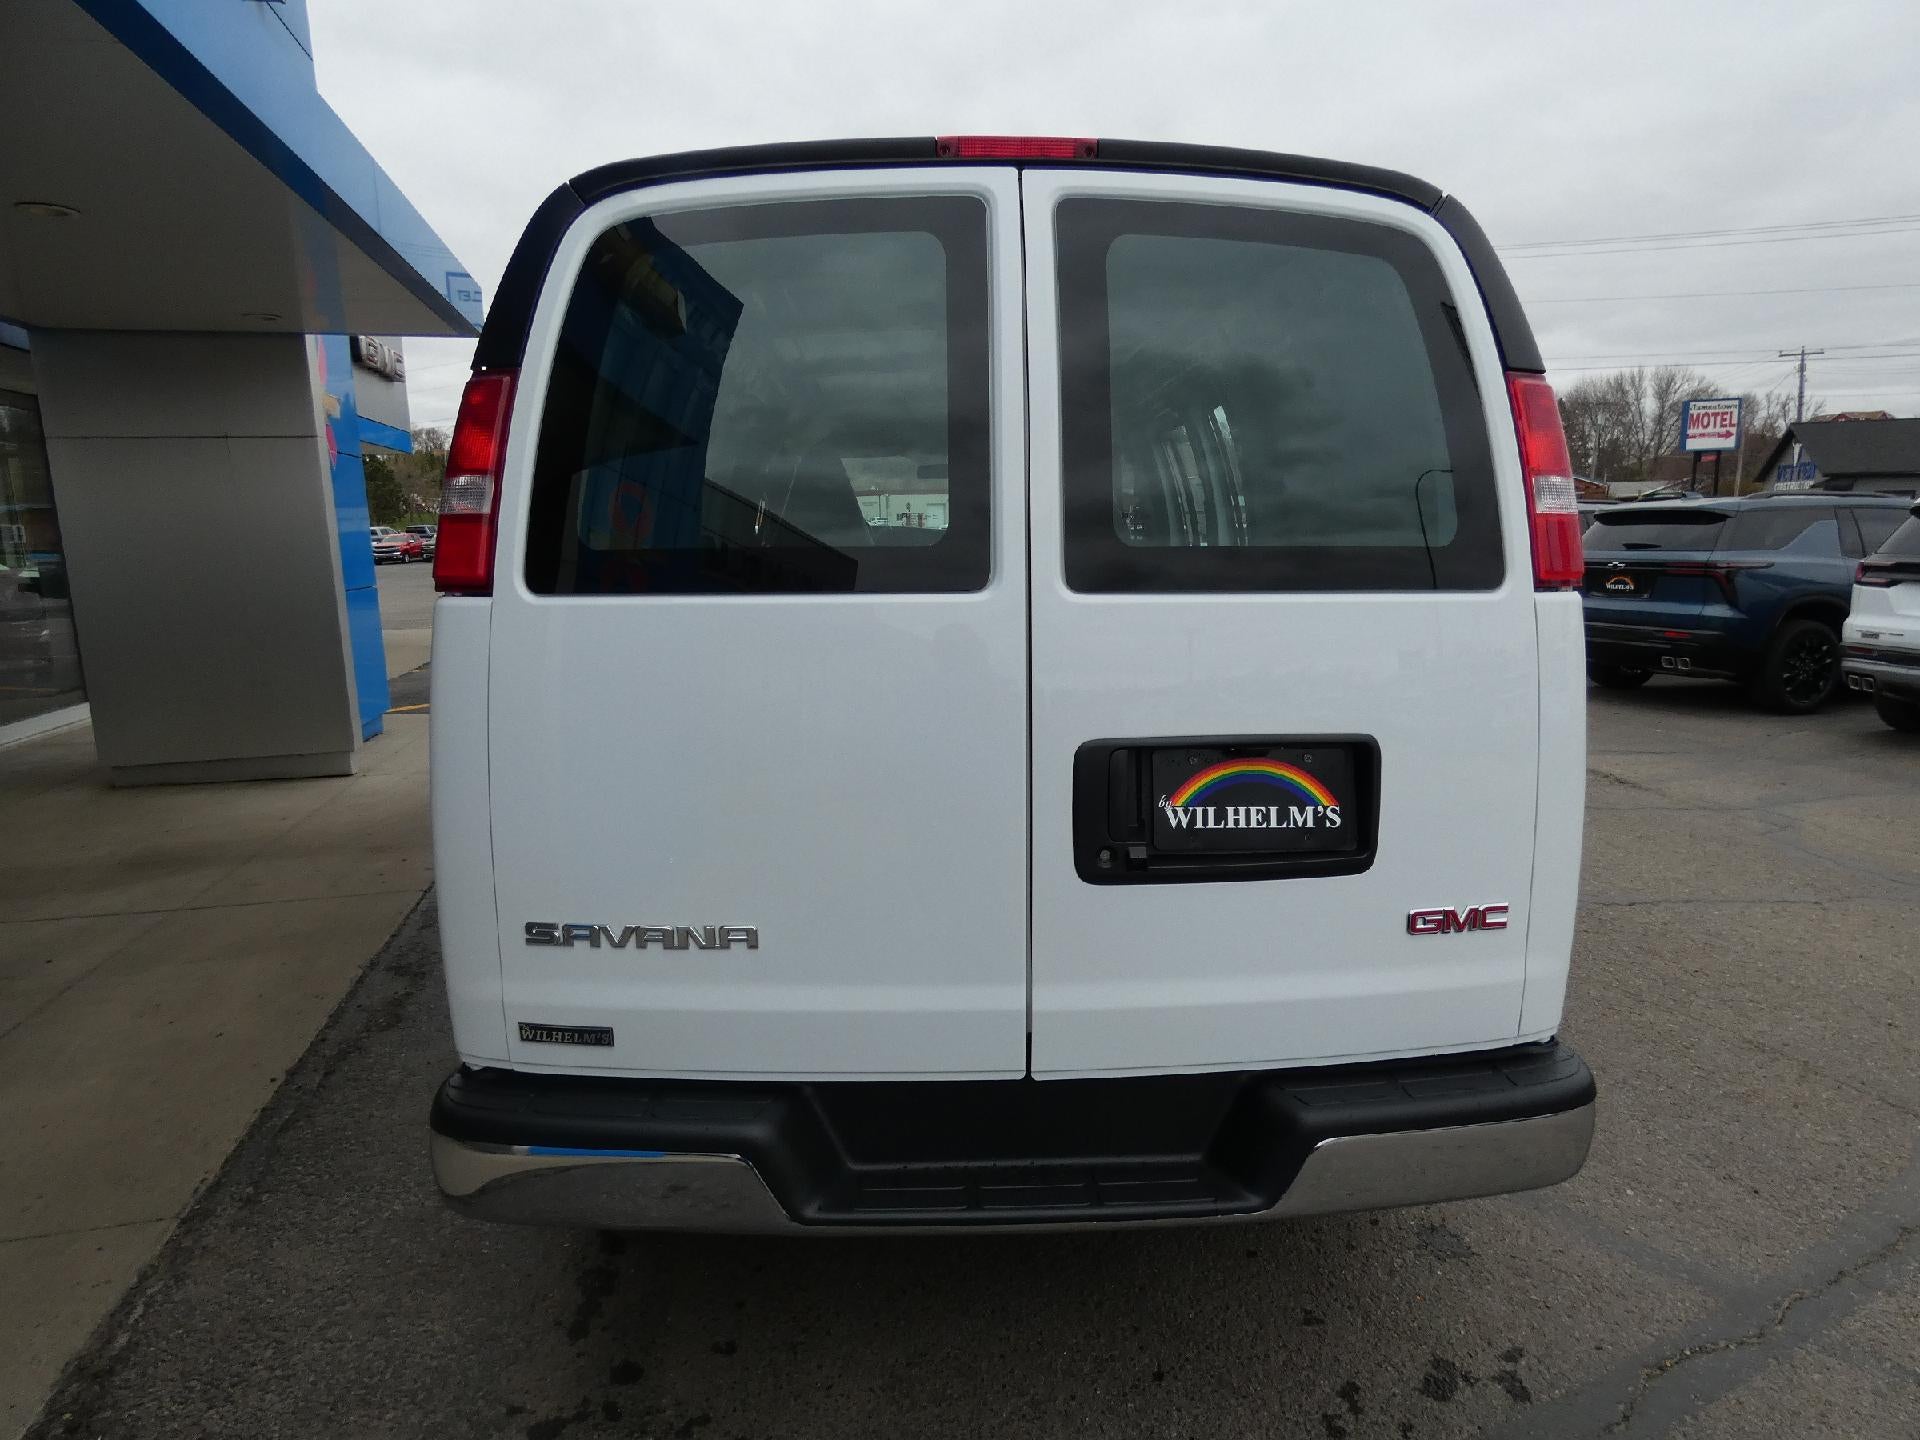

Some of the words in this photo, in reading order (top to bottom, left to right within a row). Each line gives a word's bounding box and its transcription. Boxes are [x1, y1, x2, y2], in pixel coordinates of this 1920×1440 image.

[1689, 411, 1736, 429] MOTEL
[1158, 795, 1173, 808] by
[1165, 805, 1342, 829] WILHELM'S
[1407, 902, 1509, 935] GMC
[525, 921, 759, 950] SAVANA
[521, 1029, 610, 1045] WILHELM'S
